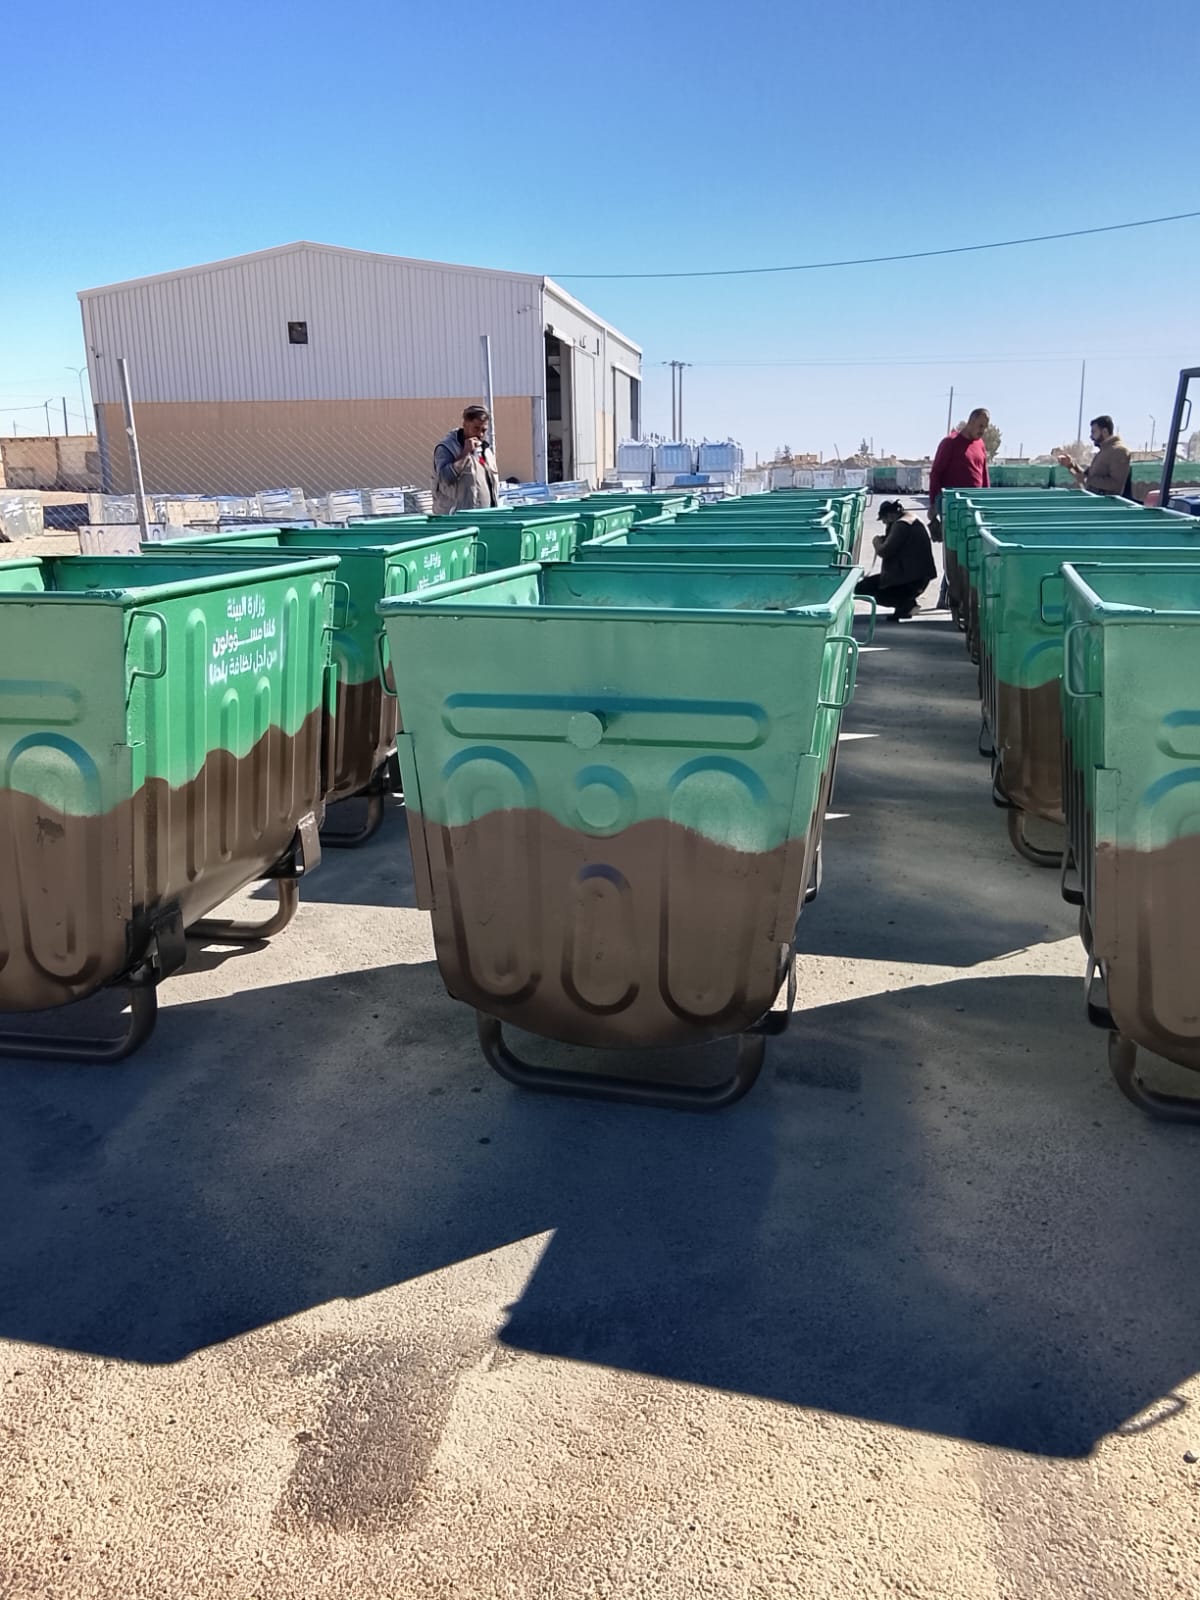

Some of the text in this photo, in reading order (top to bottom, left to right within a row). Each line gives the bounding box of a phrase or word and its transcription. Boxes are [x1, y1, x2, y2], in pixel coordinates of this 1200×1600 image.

[227, 594, 265, 621] وزارة البيئة
[213, 618, 275, 658] كلنا مسؤولون
[209, 660, 228, 686] بلدنا
[229, 652, 252, 676] نظافة
[266, 649, 278, 671] من
